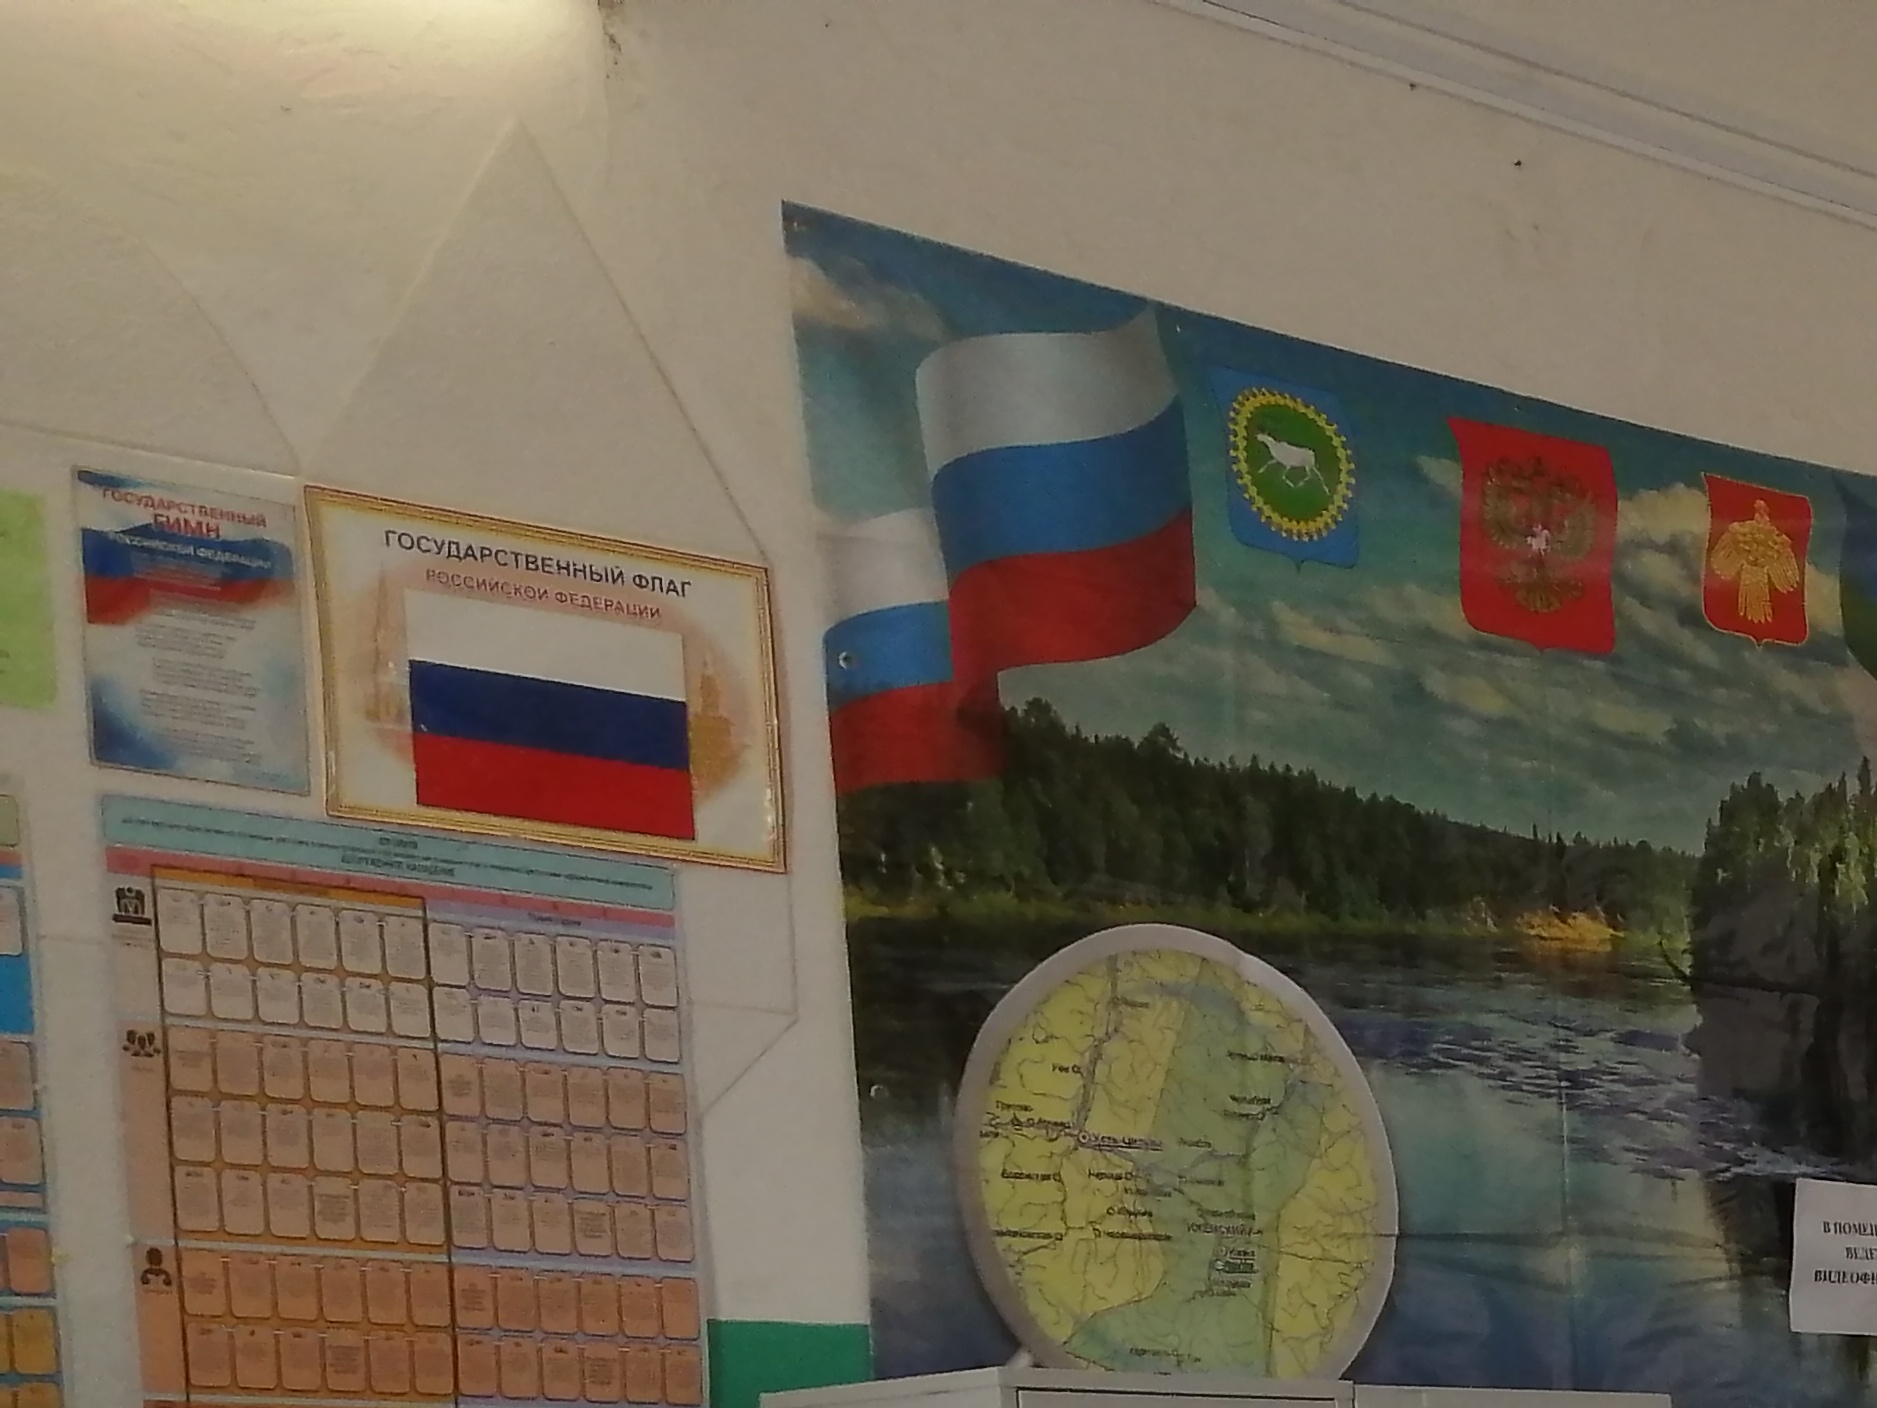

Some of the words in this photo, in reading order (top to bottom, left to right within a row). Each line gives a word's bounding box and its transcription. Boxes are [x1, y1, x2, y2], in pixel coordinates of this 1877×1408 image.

[102, 487, 268, 528] ГОСУДАРСТВЕННЫЙ
[153, 513, 221, 539] ГИМН
[384, 529, 625, 587] ГОСУДАРСТВЕННЫЙ
[632, 573, 693, 599] ФЛАГ
[426, 568, 549, 600] РОССИЙСКОЙ
[554, 590, 662, 619] ФЕДЕРАЦИИ
[1822, 1220, 1831, 1234] В
